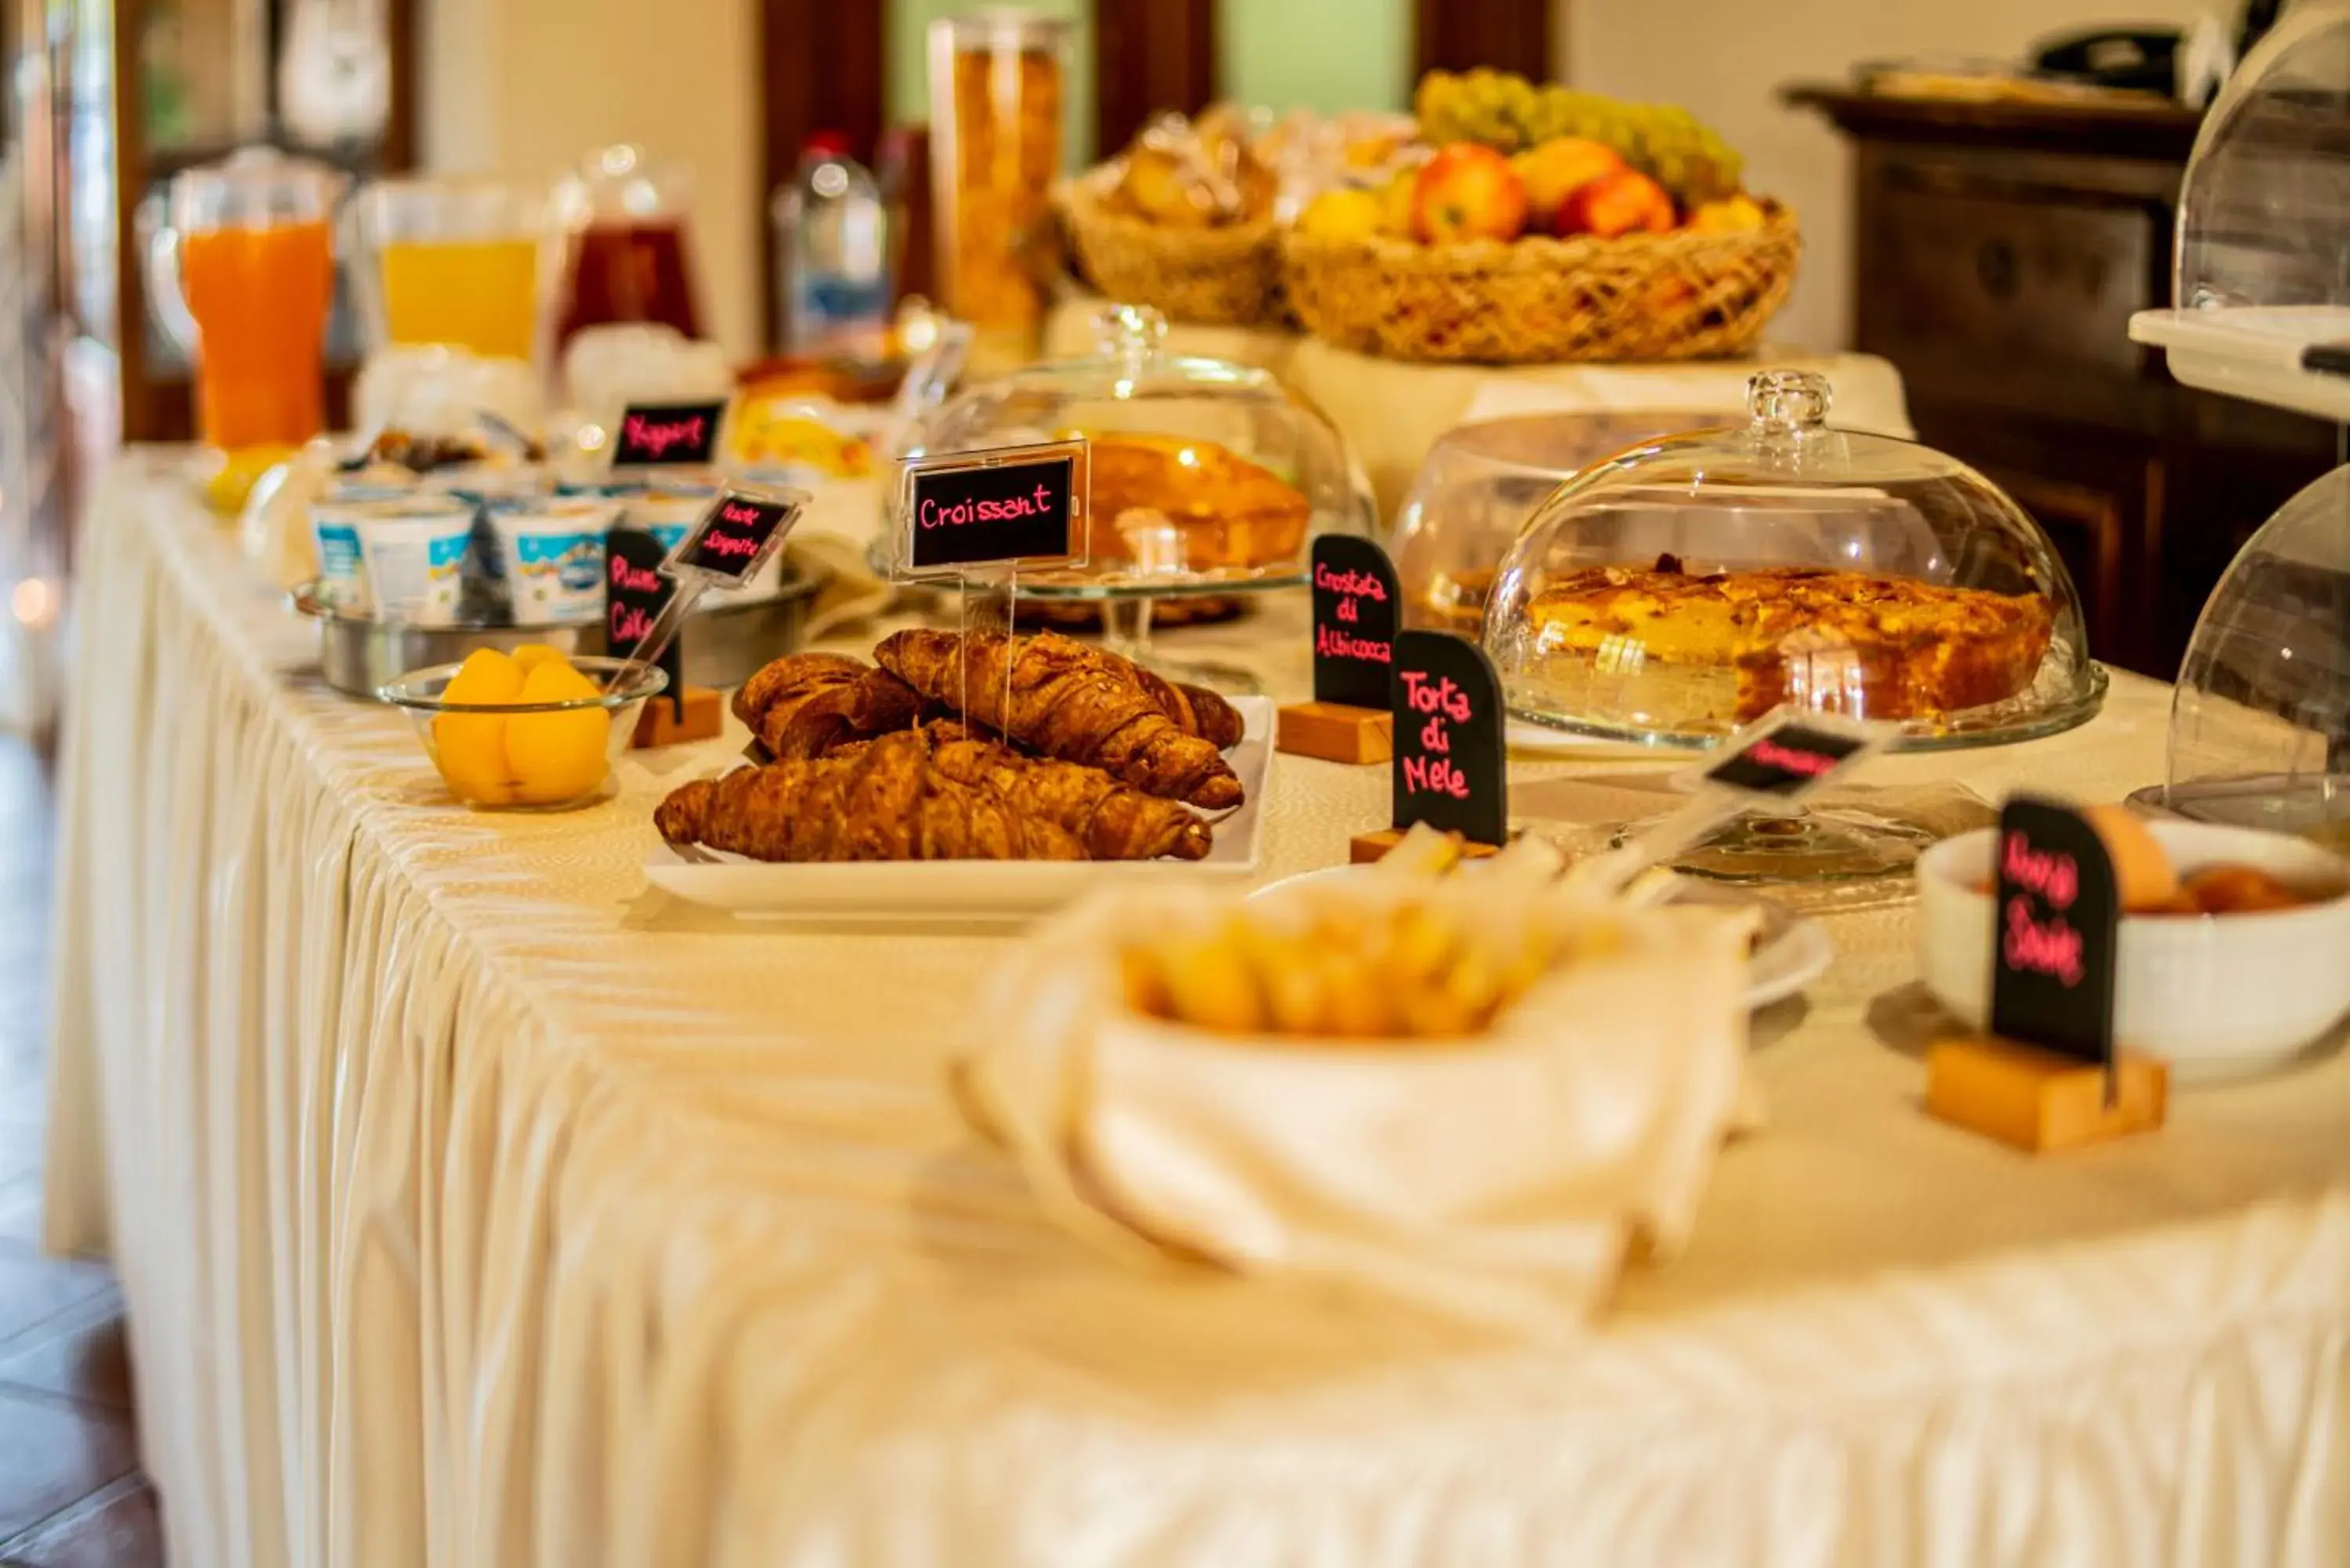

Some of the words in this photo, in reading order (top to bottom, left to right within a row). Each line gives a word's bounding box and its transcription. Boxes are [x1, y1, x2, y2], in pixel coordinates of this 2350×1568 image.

[920, 483, 1051, 529] Croissant
[1316, 562, 1387, 601] Crostata
[1336, 597, 1358, 623] di
[1317, 623, 1392, 664] Albicocca
[1400, 670, 1472, 724] Torta
[1421, 716, 1449, 753] di
[1402, 755, 1470, 798] Mele
